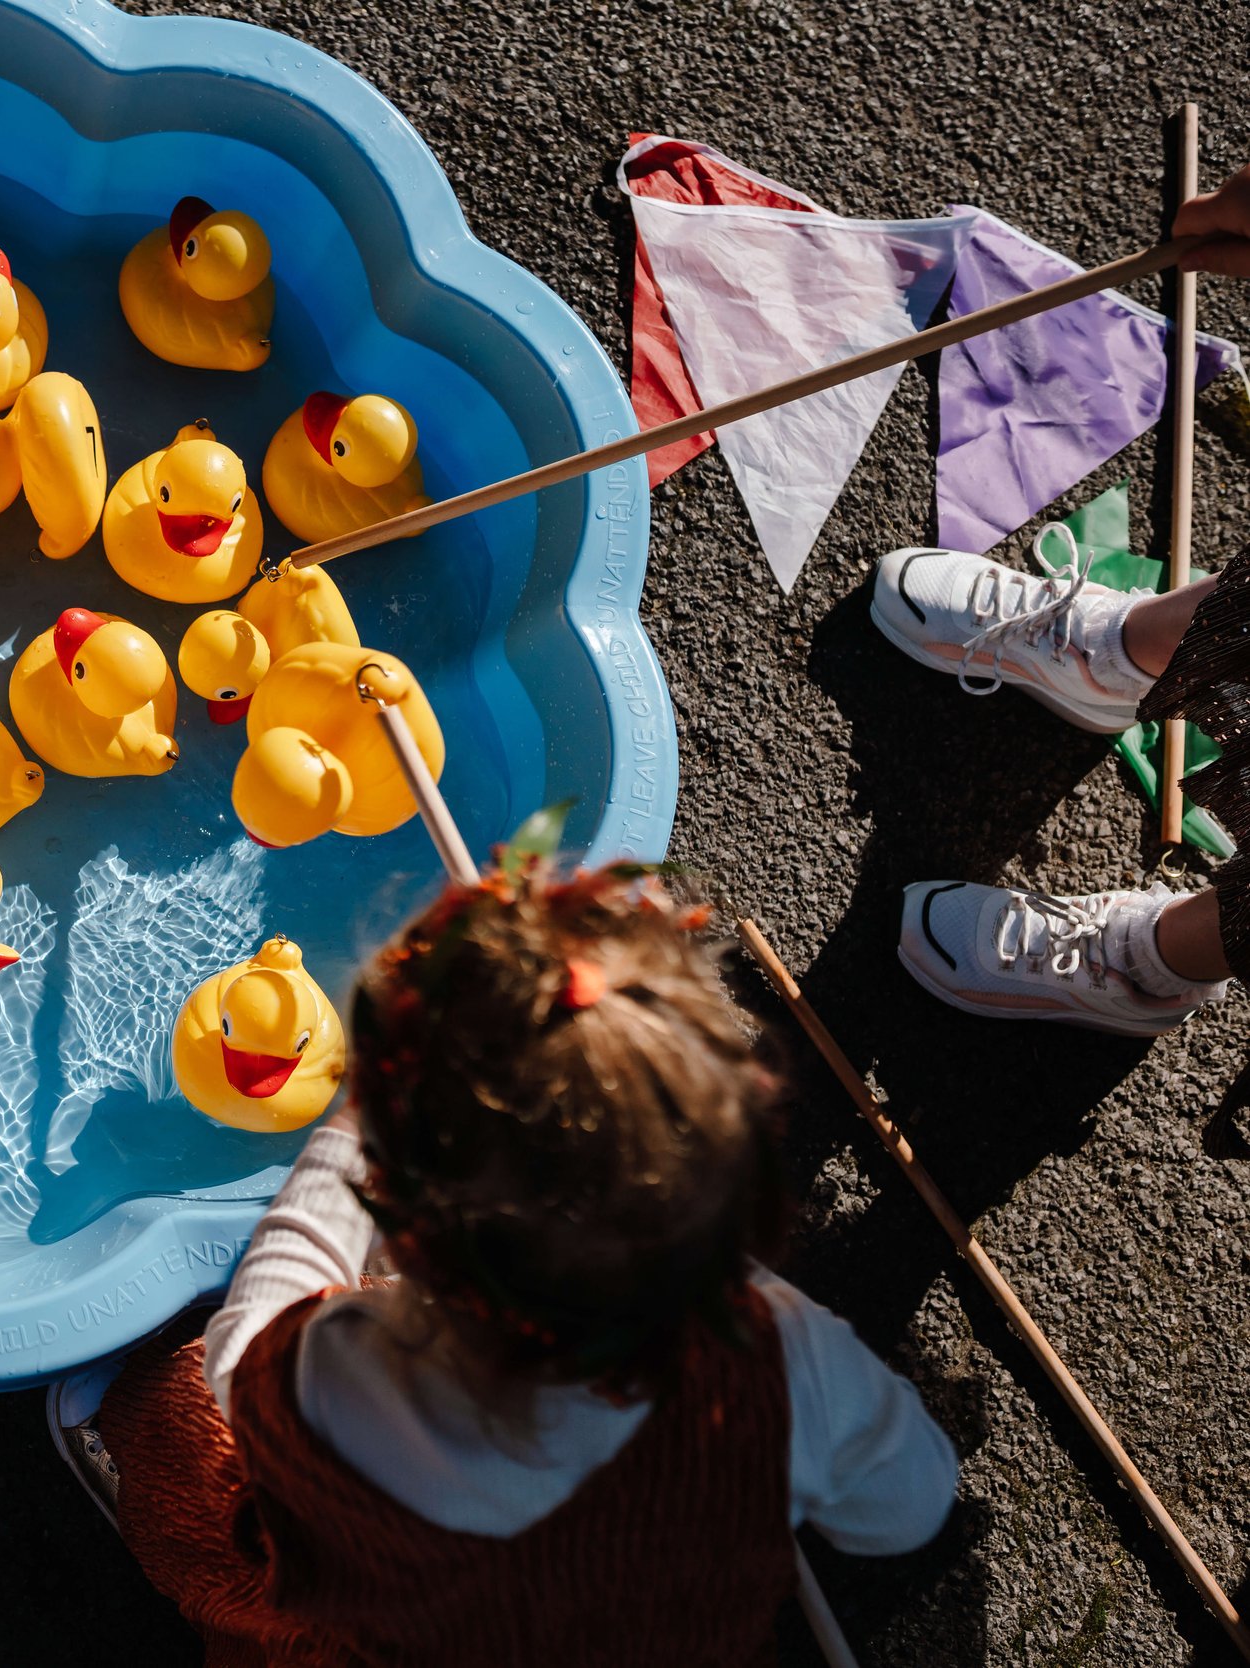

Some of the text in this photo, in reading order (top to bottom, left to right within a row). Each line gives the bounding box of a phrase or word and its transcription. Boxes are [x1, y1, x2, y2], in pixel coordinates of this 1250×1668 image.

[596, 428, 630, 624] UNATTENDD
[609, 639, 652, 718] CHILD
[629, 727, 656, 818] LEAVE
